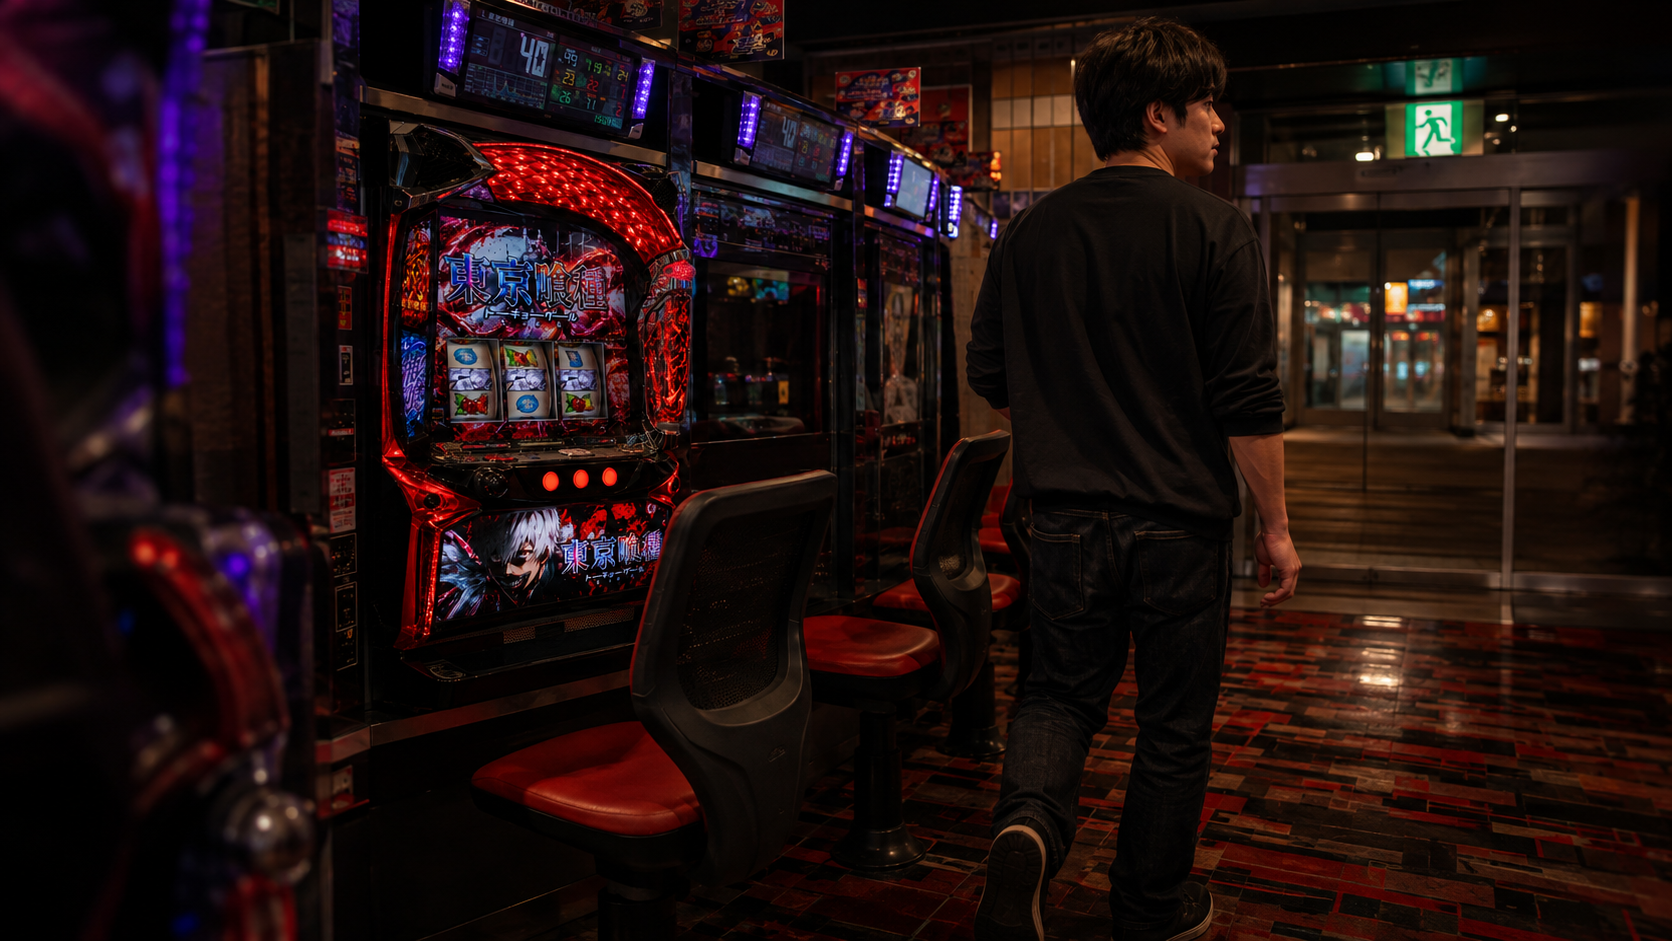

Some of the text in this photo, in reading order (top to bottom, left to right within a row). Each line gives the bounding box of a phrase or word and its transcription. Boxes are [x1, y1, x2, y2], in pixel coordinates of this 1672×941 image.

[520, 35, 549, 77] 40
[562, 72, 576, 87] 23
[444, 252, 608, 310] 東京喰種
